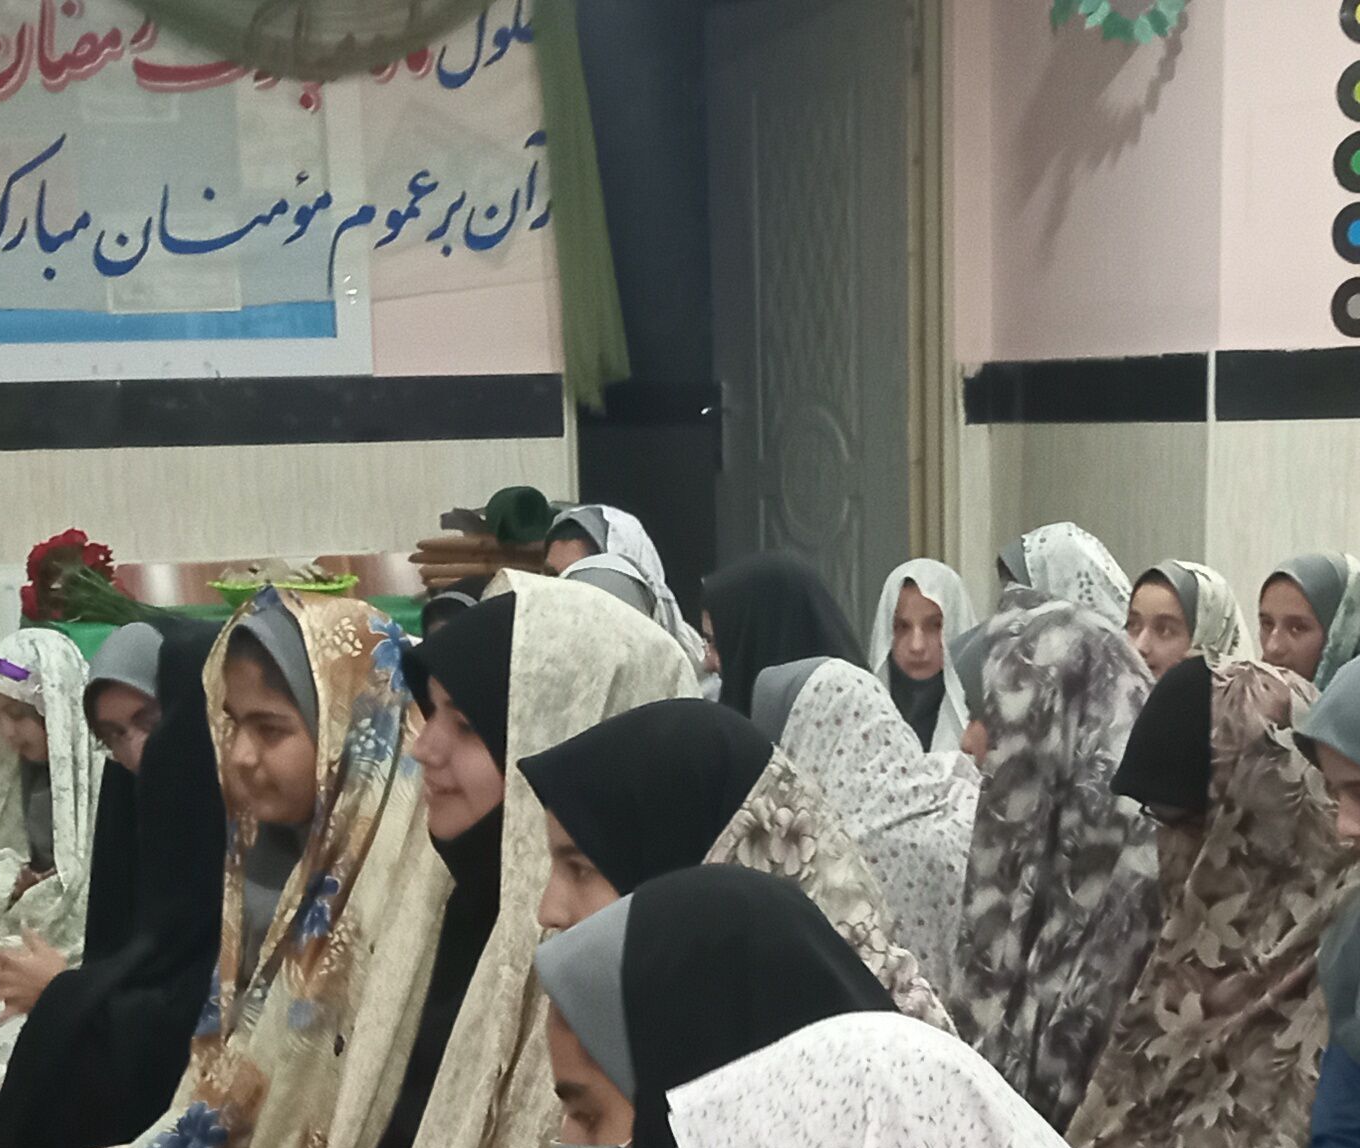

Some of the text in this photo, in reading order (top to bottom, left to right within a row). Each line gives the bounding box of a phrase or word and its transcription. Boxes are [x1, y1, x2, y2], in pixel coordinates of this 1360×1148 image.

[437, 0, 535, 89] لول
[328, 169, 439, 294] عموم
[425, 190, 467, 257] بر
[464, 130, 552, 252] رآن
